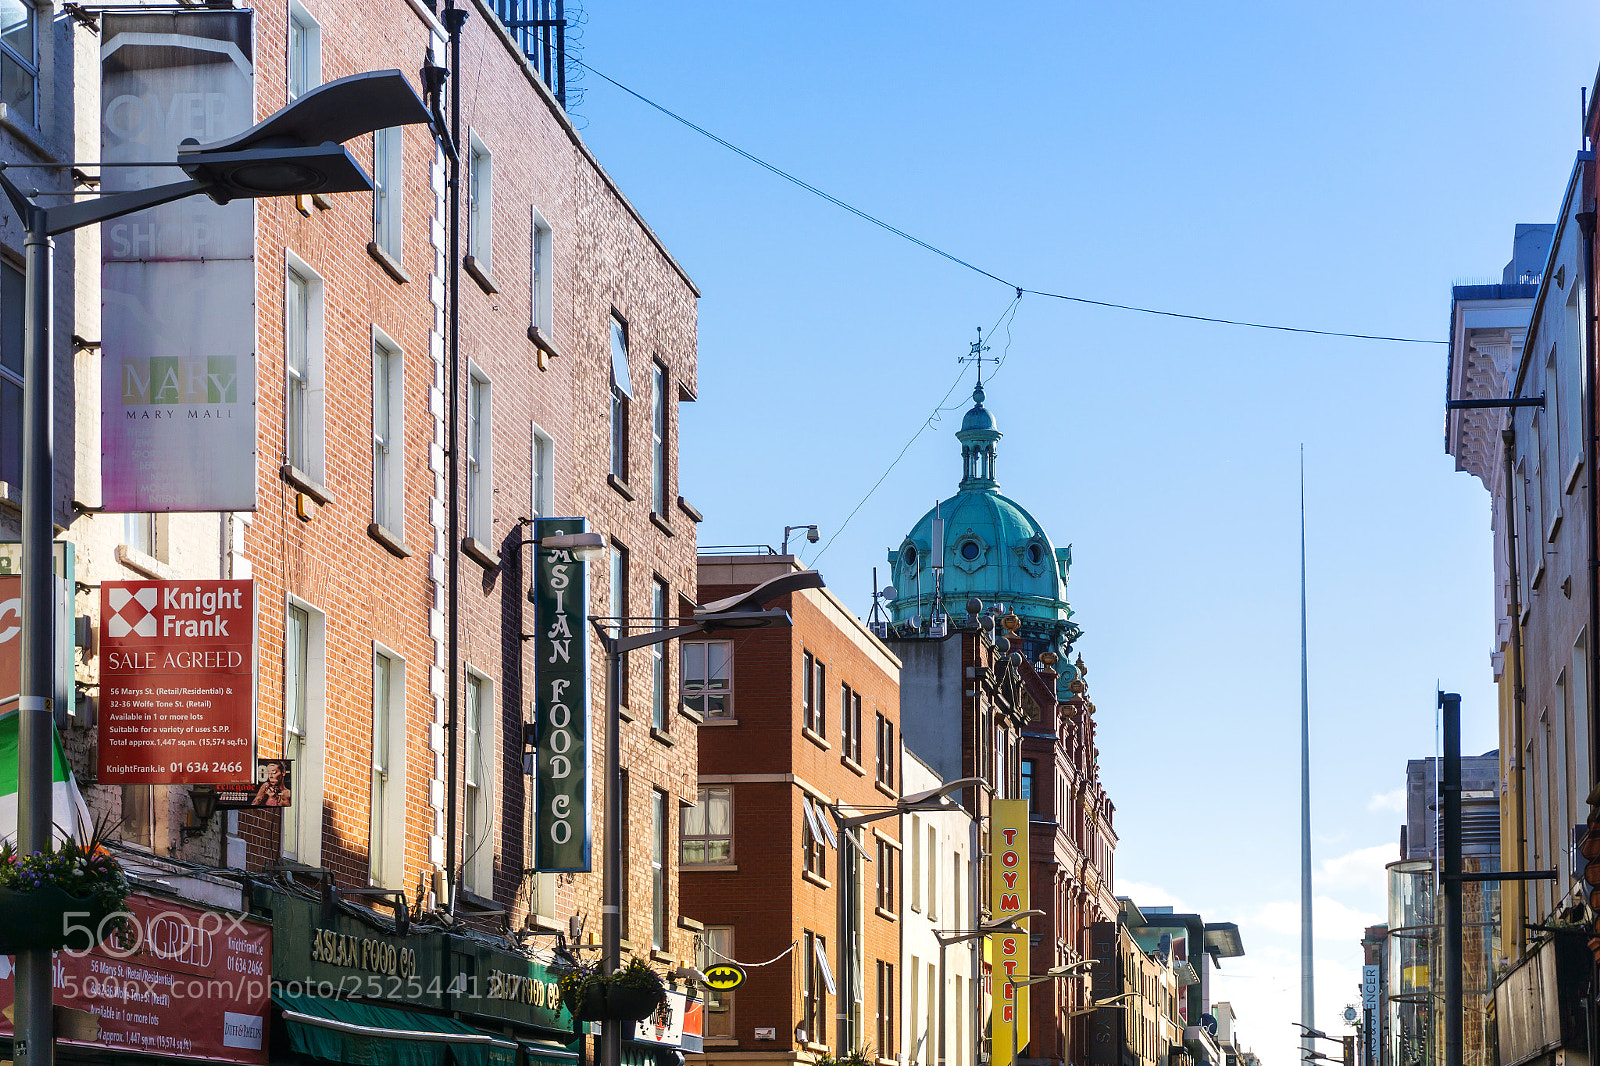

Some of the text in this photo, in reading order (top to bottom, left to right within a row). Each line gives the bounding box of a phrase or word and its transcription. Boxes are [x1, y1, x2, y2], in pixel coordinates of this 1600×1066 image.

[122, 361, 237, 404] MARY
[125, 409, 175, 420] MARY
[163, 586, 243, 616] Knight
[163, 614, 230, 637] Frank
[108, 651, 243, 670] SALE AGREED
[110, 687, 233, 697] 56 Marys St. (Retail/Residential) &
[547, 529, 574, 845] ASIAN FOOD CO
[110, 700, 212, 709] 32-36 Wolfe Tone St. (Retail)
[109, 713, 143, 721] Available
[144, 713, 152, 721] in
[190, 713, 204, 721] lots
[109, 725, 139, 733] Suitable
[140, 725, 152, 733] for
[159, 725, 184, 735] variety
[185, 725, 195, 733] of
[109, 738, 128, 746] Total
[198, 738, 226, 747] (15,574
[106, 761, 243, 775] KnightFrank.ie 01 634 2466
[999, 827, 1021, 1023] TOYMSTER
[142, 915, 213, 968] AGREED
[227, 936, 264, 956] KnightFrank.ie
[312, 927, 416, 979] ASIAN FOOD CO
[227, 955, 264, 976] 01 634 2466
[521, 976, 545, 1007] FOOD
[126, 1012, 133, 1021] or
[133, 1013, 148, 1024] more
[148, 1012, 159, 1025] lots
